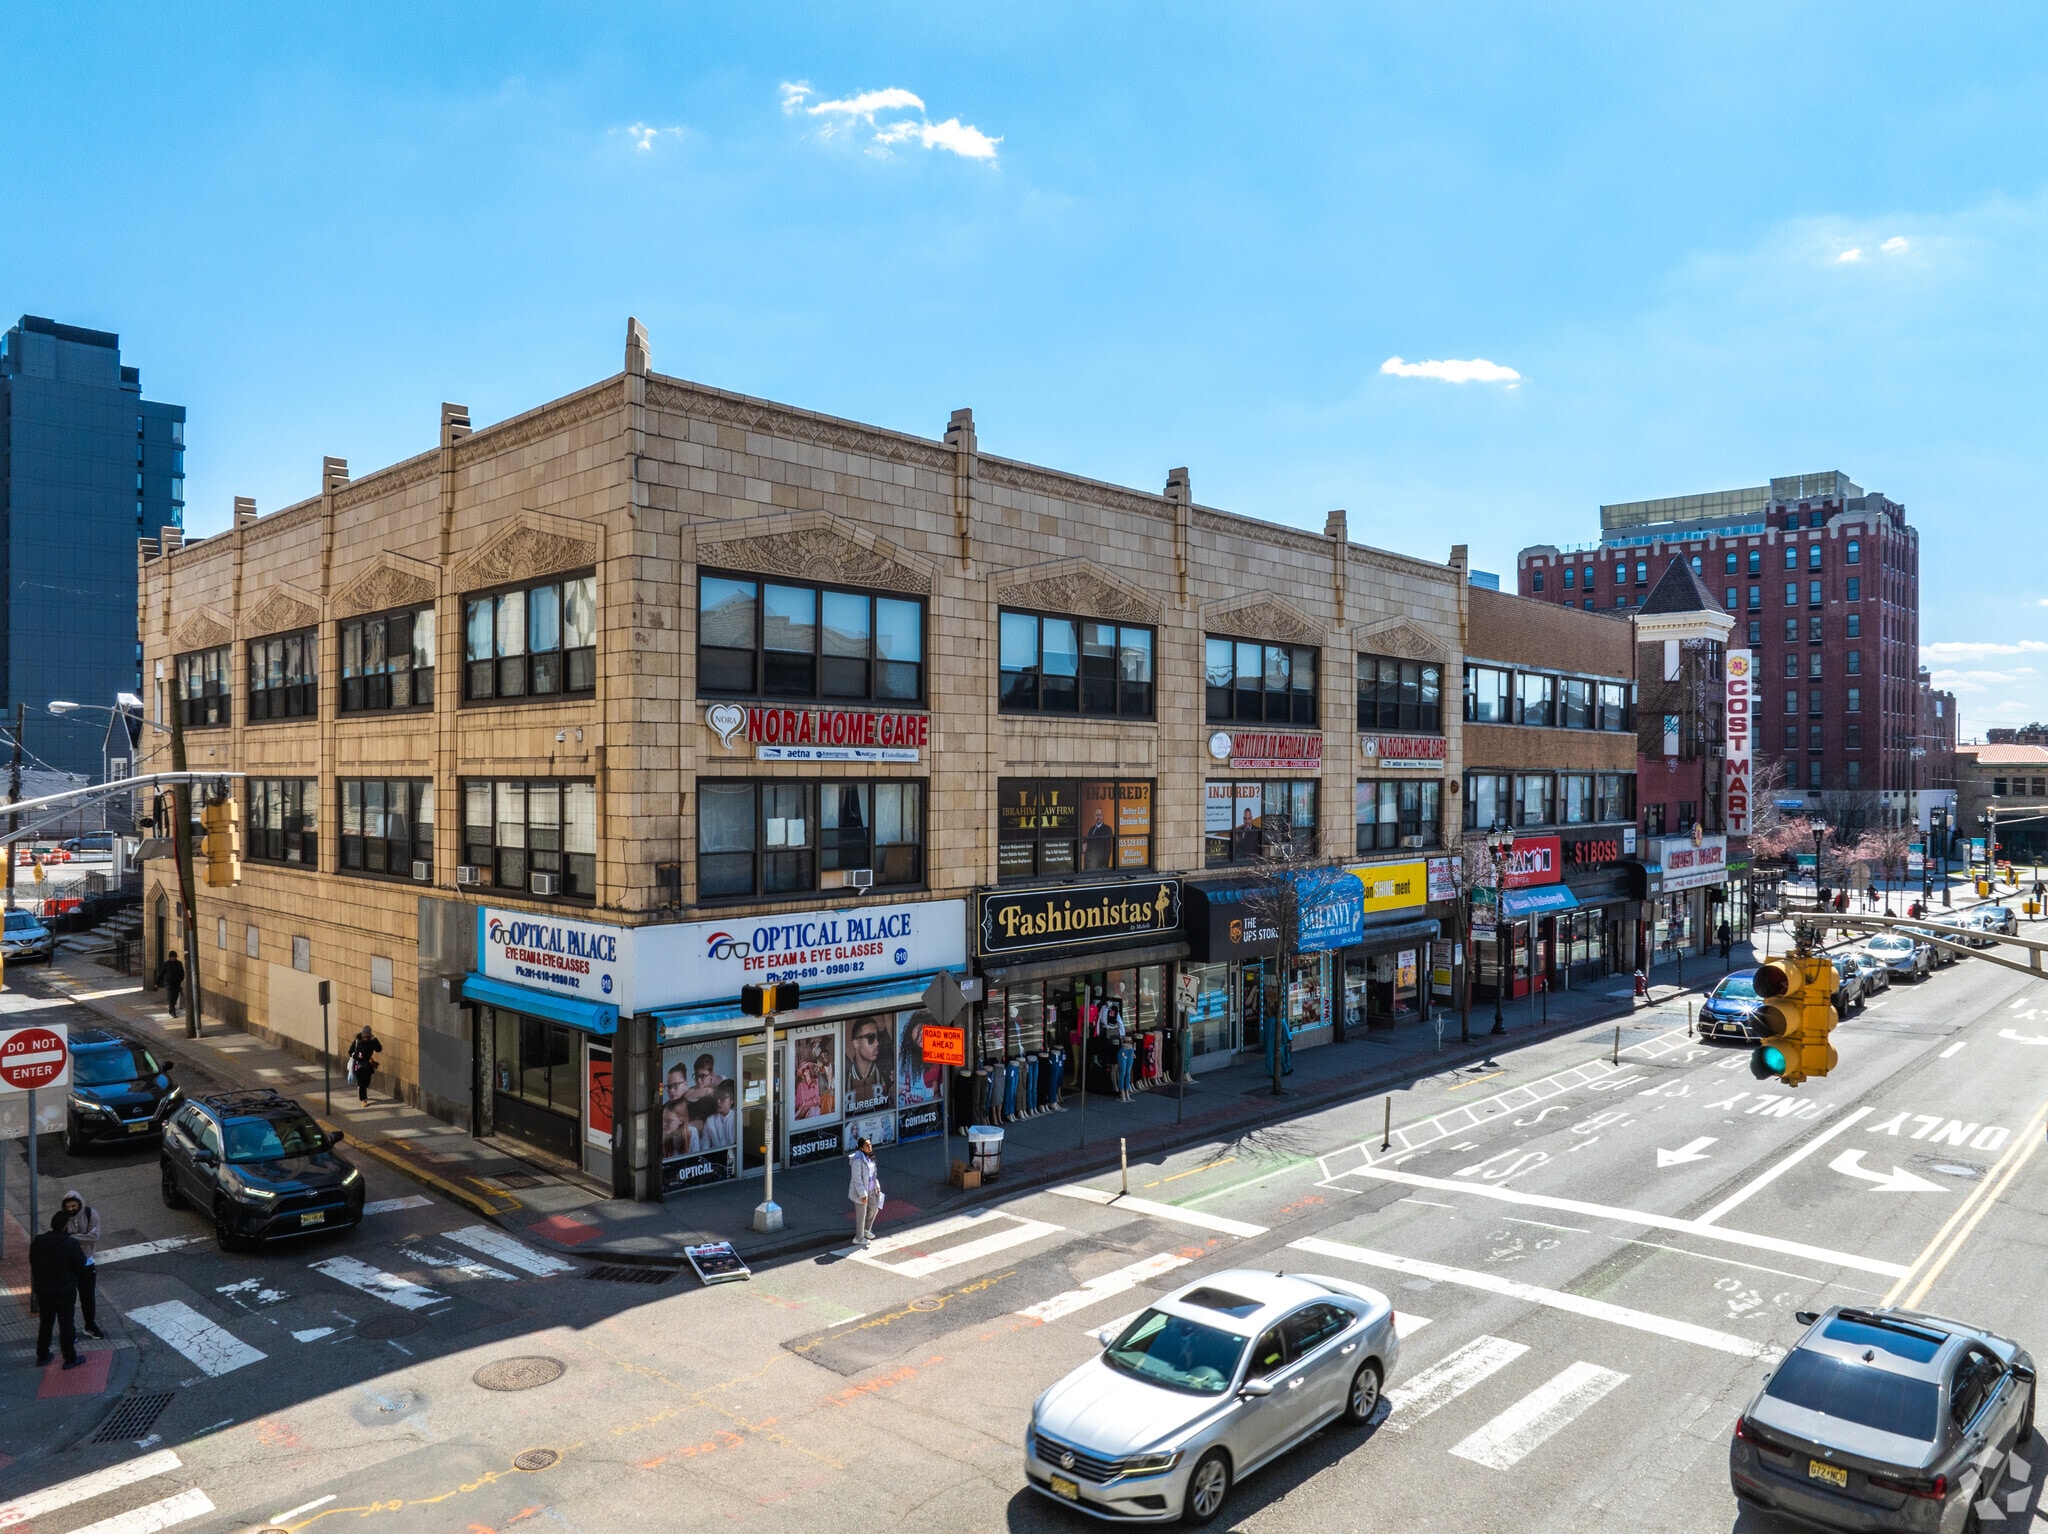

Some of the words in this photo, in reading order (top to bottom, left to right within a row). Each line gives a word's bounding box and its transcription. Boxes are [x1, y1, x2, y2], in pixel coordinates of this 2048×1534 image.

[715, 715, 737, 725] NORA
[1728, 680, 1748, 752] COST
[748, 708, 812, 743] NORA
[817, 711, 876, 746] HOME
[880, 714, 927, 746] CARE
[1232, 734, 1267, 757] INSTITUTE
[1268, 735, 1277, 757] OF
[1278, 735, 1305, 758] MEDICAL
[1306, 736, 1322, 758] ARTS
[1378, 737, 1386, 757] NJ
[1388, 737, 1412, 757] GOLDEN
[1414, 738, 1430, 758] HOME
[1431, 738, 1446, 758] CARE
[787, 750, 810, 759] aetna
[1086, 786, 1149, 800] INJURED?
[1208, 786, 1260, 799] INJURED?
[1002, 807, 1036, 817] IBRAHIM
[1057, 806, 1074, 816] FIRM
[1669, 850, 1697, 869] COST
[1650, 882, 1660, 892] 900
[998, 897, 1152, 938] Fashionistas
[1243, 916, 1257, 929] THE
[510, 921, 565, 954] OPTICAL
[567, 930, 617, 962] PALACE
[752, 920, 842, 954] OPTICAL
[846, 914, 912, 943] PALACE
[1243, 930, 1257, 942] UPS
[505, 947, 518, 961] EYE
[520, 949, 536, 964] EXAM
[537, 952, 542, 965] &
[543, 953, 556, 968] EYE
[557, 956, 590, 975] GLASSES
[744, 956, 765, 971] EYE
[767, 952, 797, 967] EXAM
[800, 953, 807, 964] &
[810, 948, 831, 962] EYE
[835, 942, 884, 960] GLASSES
[895, 950, 908, 962] 910
[600, 977, 612, 990] 910
[795, 1022, 836, 1035] GUCCI
[924, 1029, 941, 1039] ROAD
[943, 1031, 962, 1041] WORK
[8, 1042, 25, 1053] DO
[32, 1038, 57, 1050] NOT
[664, 1043, 698, 1058] EMPORIO
[932, 1040, 954, 1050] AHEAD
[923, 1050, 933, 1058] BIKE
[934, 1052, 945, 1060] LANE
[946, 1053, 963, 1062] CLOSED
[13, 1065, 52, 1080] ENTER
[848, 1096, 889, 1112] BURBERRY
[905, 1111, 938, 1128] CONTACTS
[1866, 1112, 2011, 1151] ONLY
[792, 1137, 838, 1157] EYEGLASSES
[678, 1162, 714, 1181] OPTICAL
